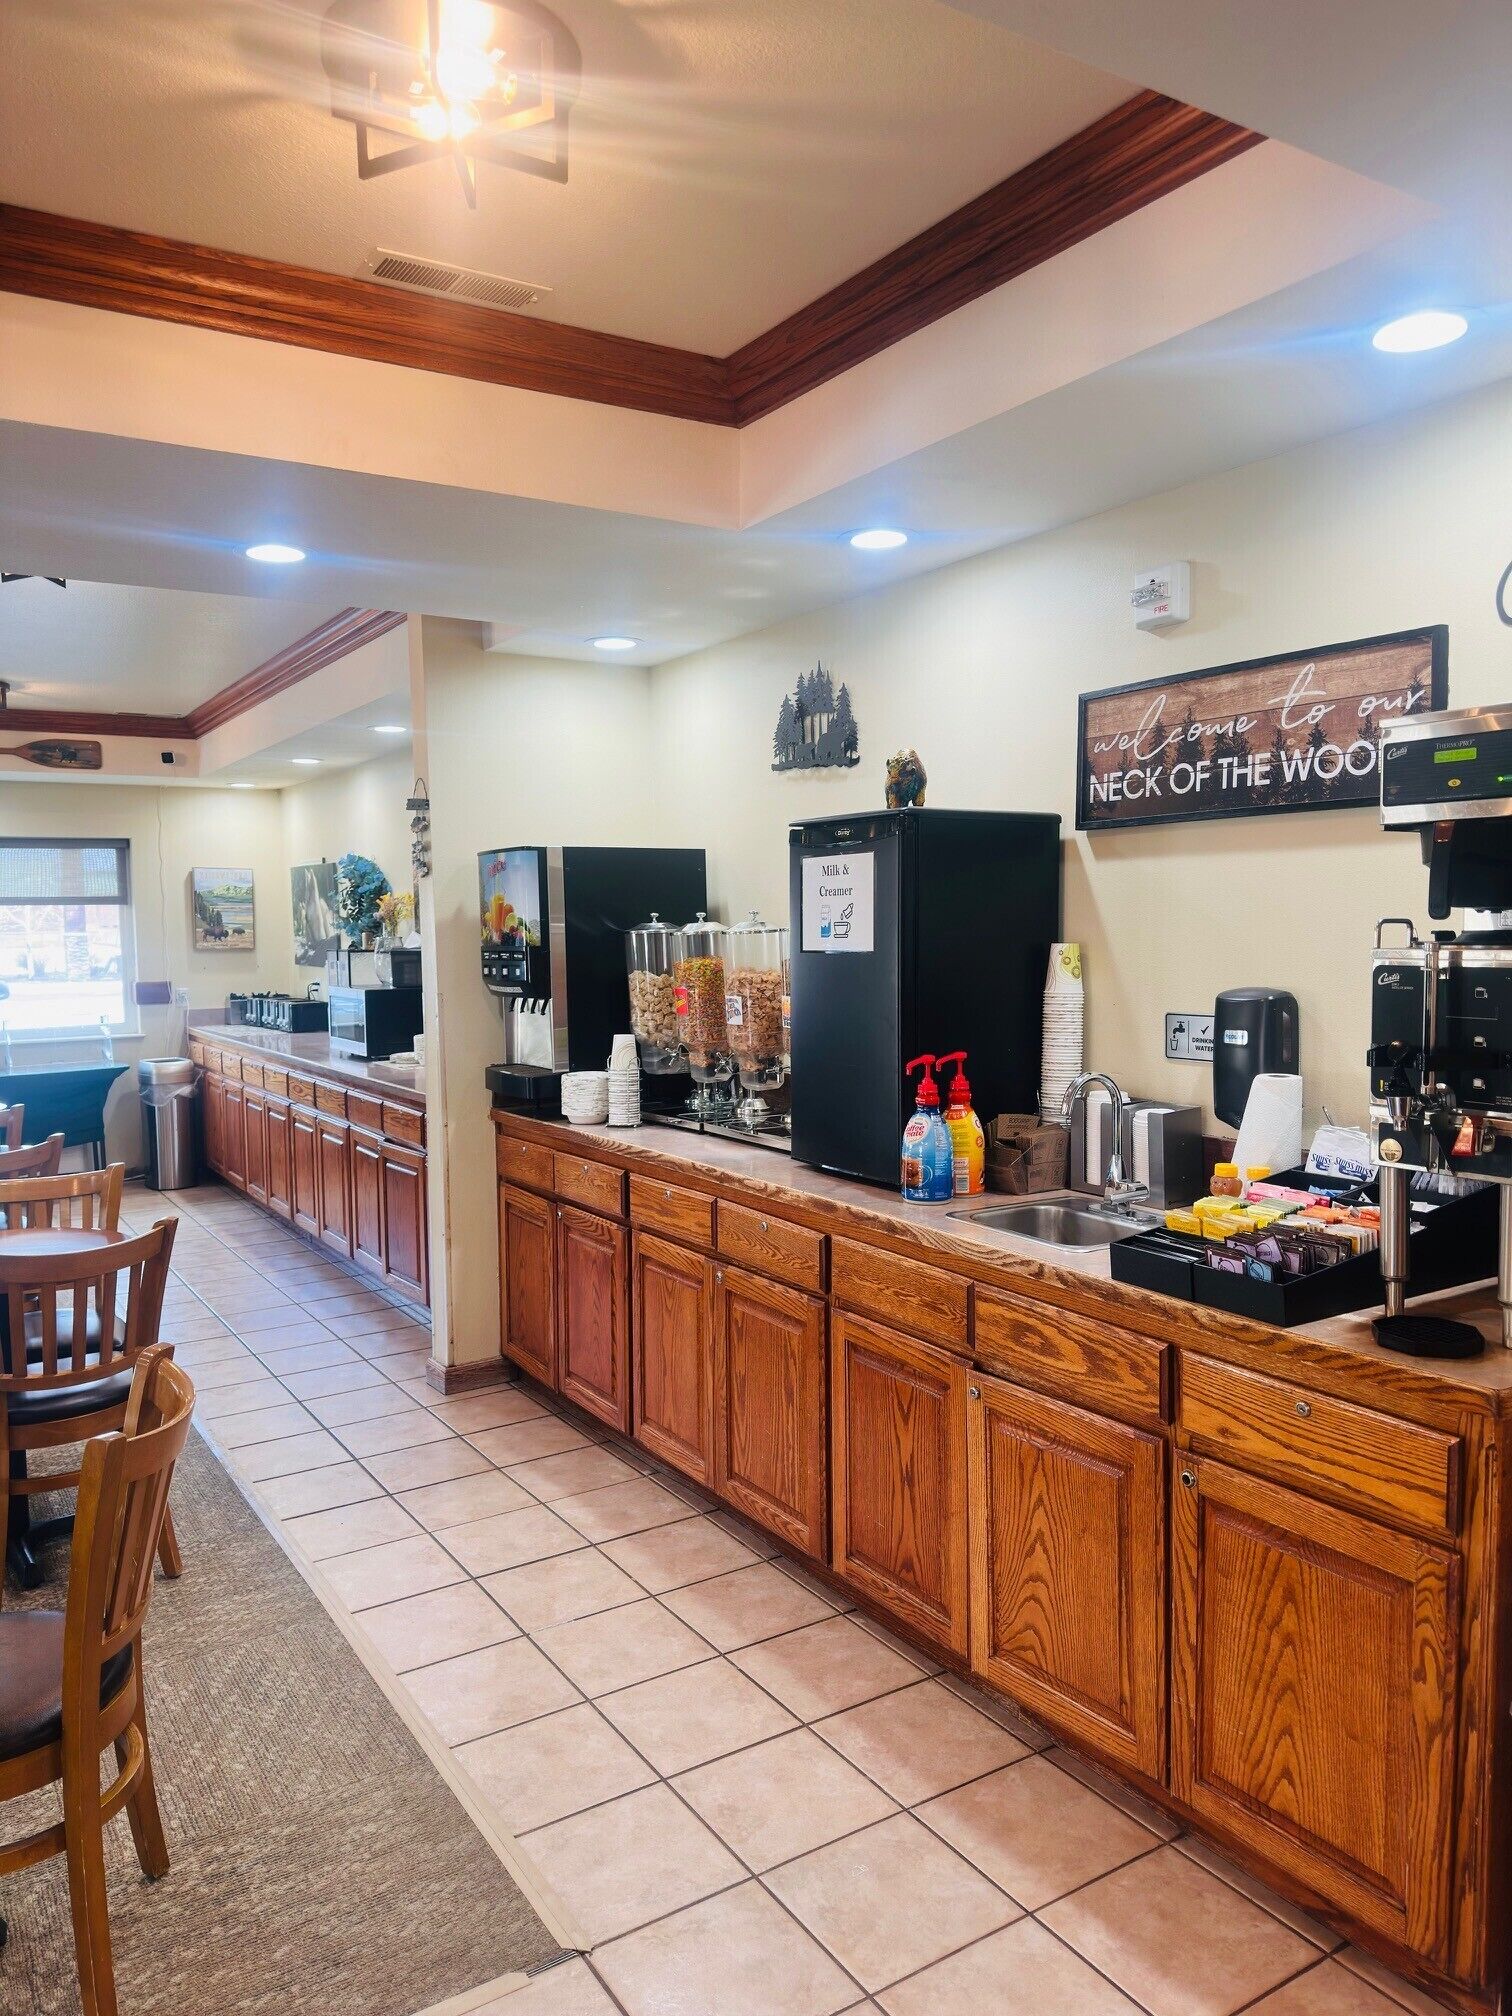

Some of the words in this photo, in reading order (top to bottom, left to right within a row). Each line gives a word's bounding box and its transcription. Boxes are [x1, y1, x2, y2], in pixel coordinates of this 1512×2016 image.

[1094, 694, 1258, 760] welcome
[1268, 663, 1336, 730] to
[1357, 689, 1426, 718] our
[1089, 766, 1164, 804] NECK
[1169, 760, 1211, 795] OF
[1217, 752, 1272, 789] THE
[1280, 739, 1382, 784] WOO
[821, 864, 840, 877] Milk
[842, 864, 850, 876] &
[819, 885, 854, 897] Creamer
[1377, 972, 1401, 986] Curtis
[1192, 1037, 1215, 1045] DRINKIN
